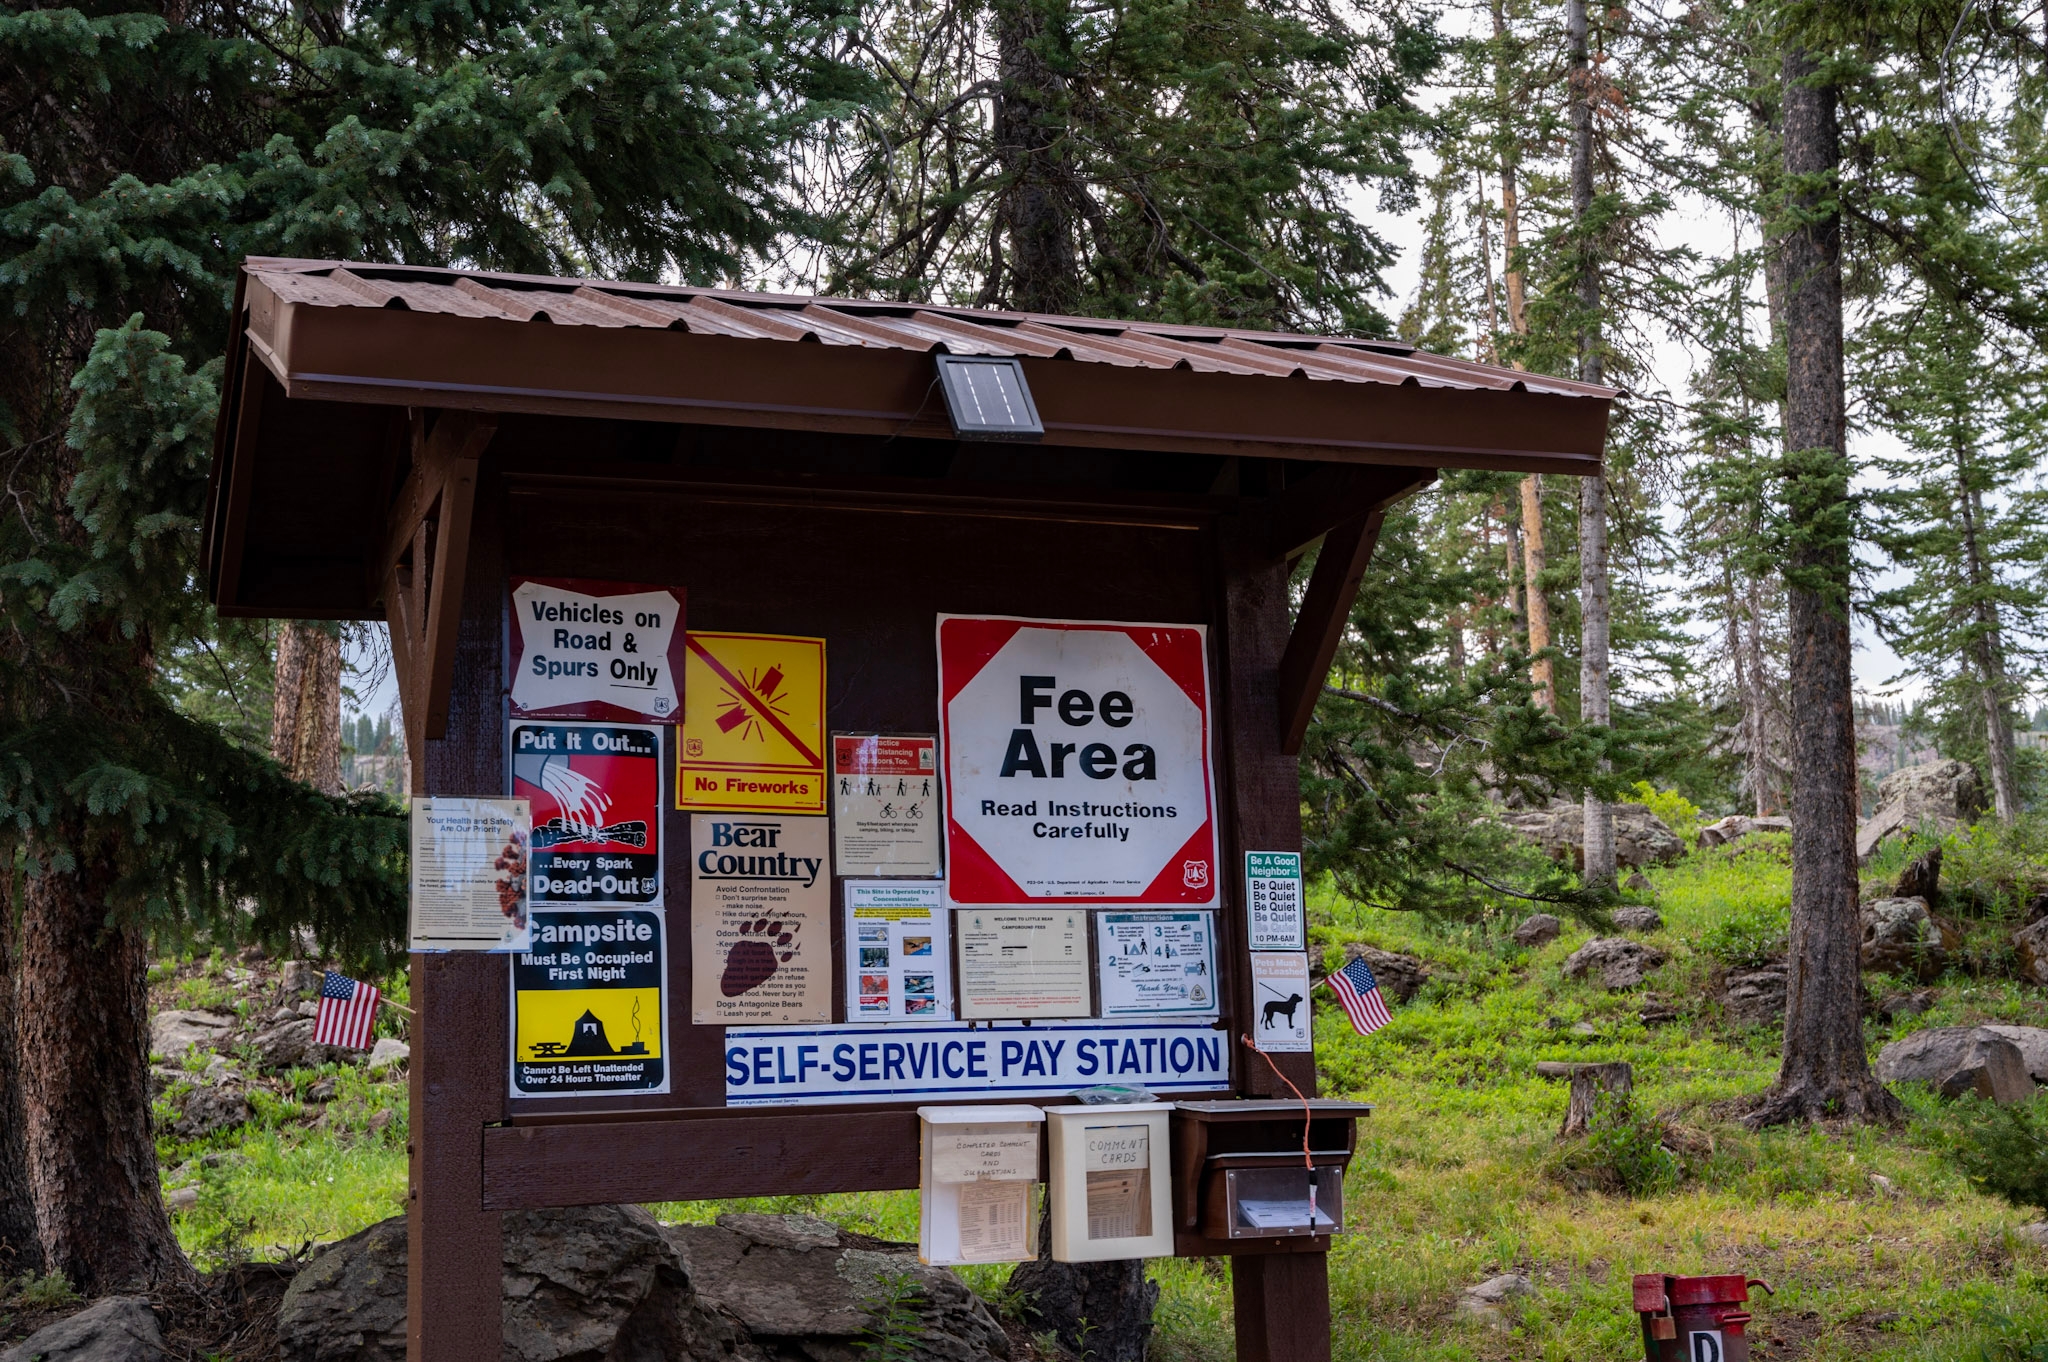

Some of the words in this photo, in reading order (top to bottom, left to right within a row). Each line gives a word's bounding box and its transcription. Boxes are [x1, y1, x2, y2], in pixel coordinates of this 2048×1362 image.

[531, 601, 624, 625] Vehicles
[635, 613, 661, 628] on
[554, 629, 611, 651] Road
[623, 633, 638, 653] &
[532, 655, 599, 680] Spurs
[610, 658, 658, 686] Only
[1020, 675, 1134, 728] Fee
[519, 731, 556, 750] Put
[566, 732, 581, 750] It
[592, 733, 651, 754] Out...
[878, 749, 913, 757] Distancing
[999, 729, 1157, 780] Area
[695, 777, 718, 792] No
[725, 778, 809, 795] Fireworks
[981, 800, 1037, 816] Read
[1049, 800, 1177, 818] Instructions
[426, 816, 444, 824] Your
[446, 817, 471, 825] Health
[490, 818, 515, 827] Safety
[456, 825, 470, 833] Our
[473, 825, 501, 834] Priority
[1033, 822, 1130, 842] Carefully
[711, 823, 781, 848] Bear
[539, 857, 590, 871] ...Every
[596, 857, 633, 871] Spark
[1251, 856, 1262, 865] Be
[1265, 856, 1272, 865] A
[1274, 856, 1296, 866] Good
[698, 850, 822, 888] Country
[1251, 867, 1290, 877] Neighbor
[533, 875, 639, 895] Dead-Out
[739, 886, 790, 894] Confrontation
[1253, 881, 1266, 890] Be
[1269, 880, 1295, 890] Quiet
[1254, 891, 1266, 900] Be
[1269, 891, 1296, 901] Quiet
[1254, 902, 1267, 911] Be
[1269, 902, 1296, 912] Quiet
[1254, 912, 1268, 921] Be
[1270, 912, 1296, 922] Quiet
[1108, 925, 1114, 936] 1
[1154, 926, 1163, 937] 3
[1154, 946, 1162, 957] 4
[521, 953, 556, 965] Must
[561, 952, 581, 965] Be
[585, 951, 653, 966] Occupied
[1108, 956, 1117, 966] 2
[1255, 959, 1274, 967] Pets
[1276, 959, 1297, 967] Must
[549, 968, 583, 980] First
[587, 967, 626, 982] Night
[1256, 967, 1267, 975] Be
[1269, 967, 1305, 975] Leashed
[1135, 984, 1160, 993] Thank
[1163, 983, 1179, 993] You
[726, 1040, 988, 1086] SELF-SERVICE
[1001, 1039, 1065, 1078] PAY
[1076, 1037, 1220, 1077] STATION
[523, 1065, 556, 1074] Cannot
[558, 1065, 570, 1074] Be
[573, 1064, 591, 1073] Left
[593, 1063, 644, 1073] Unattended
[525, 1075, 548, 1084] Over
[550, 1075, 563, 1083] 24
[565, 1074, 592, 1083] Hours
[594, 1073, 641, 1083] Thereafter
[1089, 1137, 1148, 1151] COMMENT
[1101, 1152, 1137, 1164] CARDS
[1693, 1332, 1720, 1362] D
